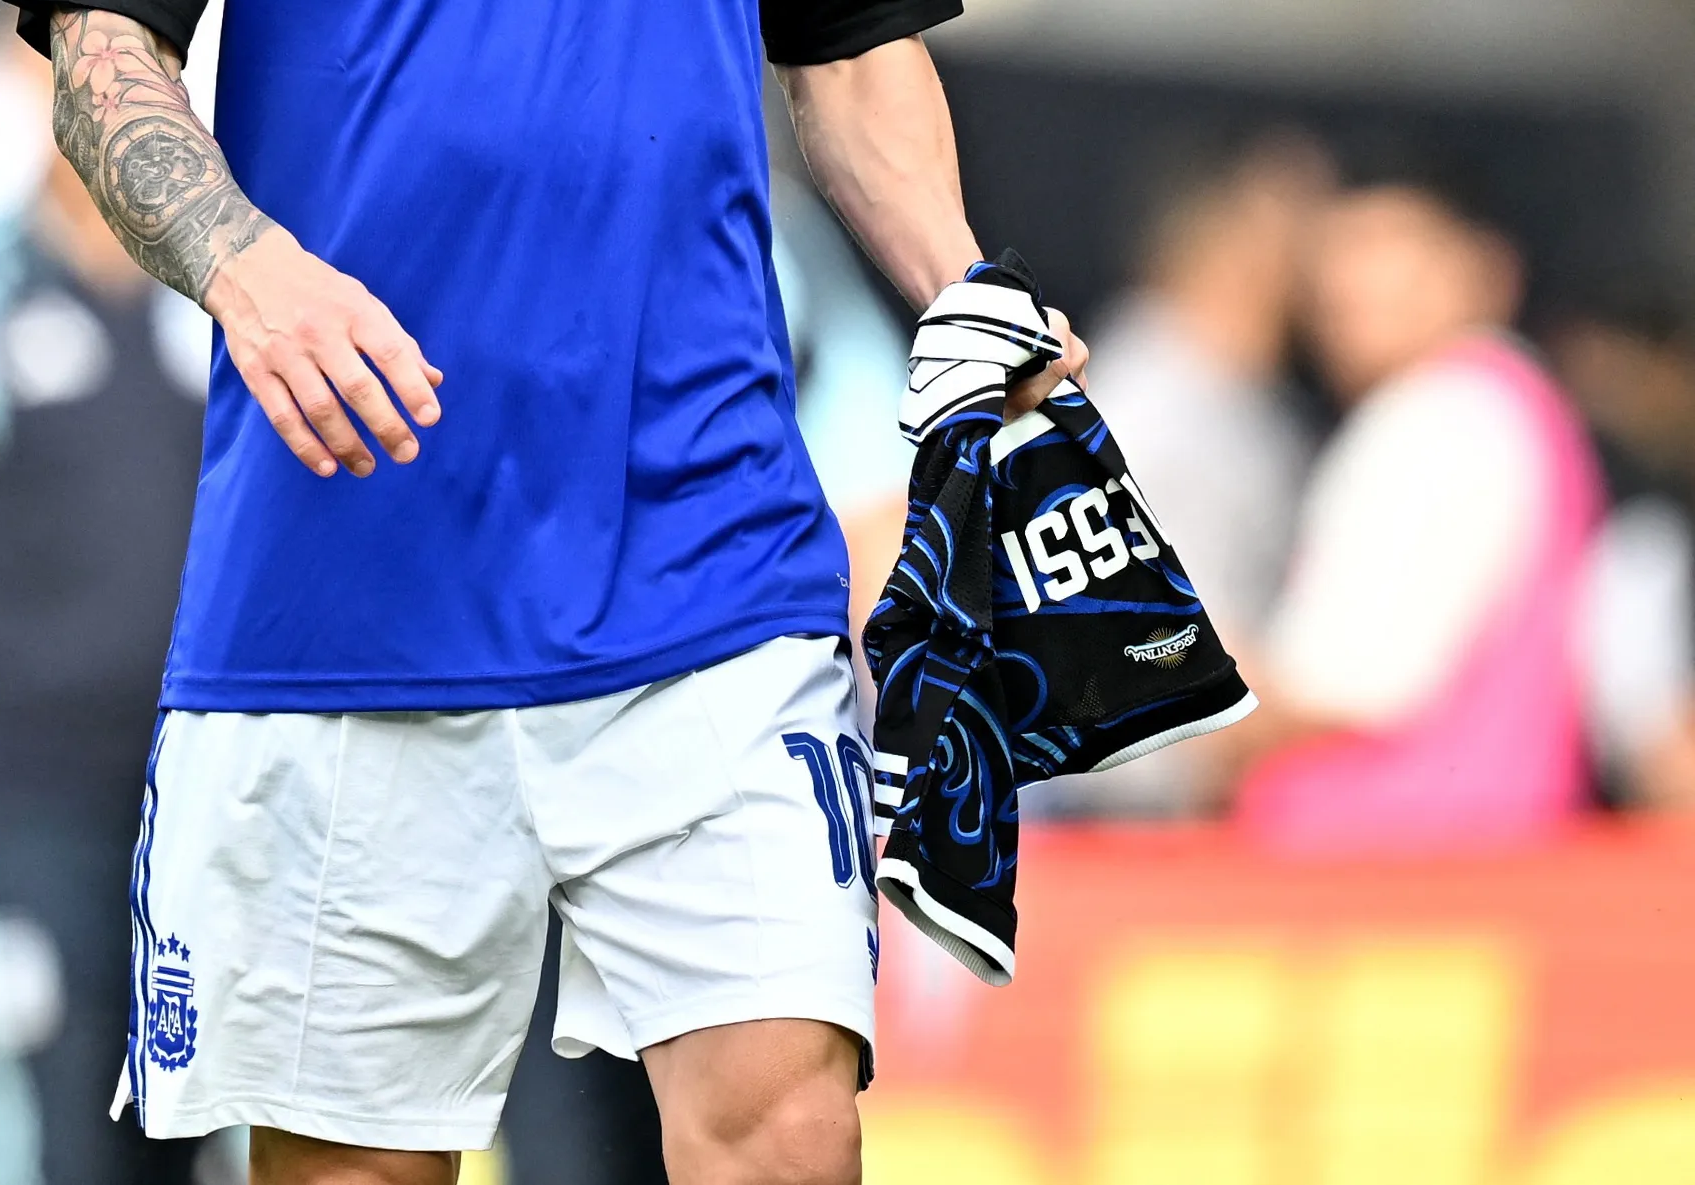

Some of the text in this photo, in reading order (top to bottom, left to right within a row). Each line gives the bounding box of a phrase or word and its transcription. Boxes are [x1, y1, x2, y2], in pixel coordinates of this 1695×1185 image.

[1001, 472, 1172, 614] ESSI
[1128, 629, 1197, 662] ARGENTINA
[156, 992, 184, 1042] AFA
